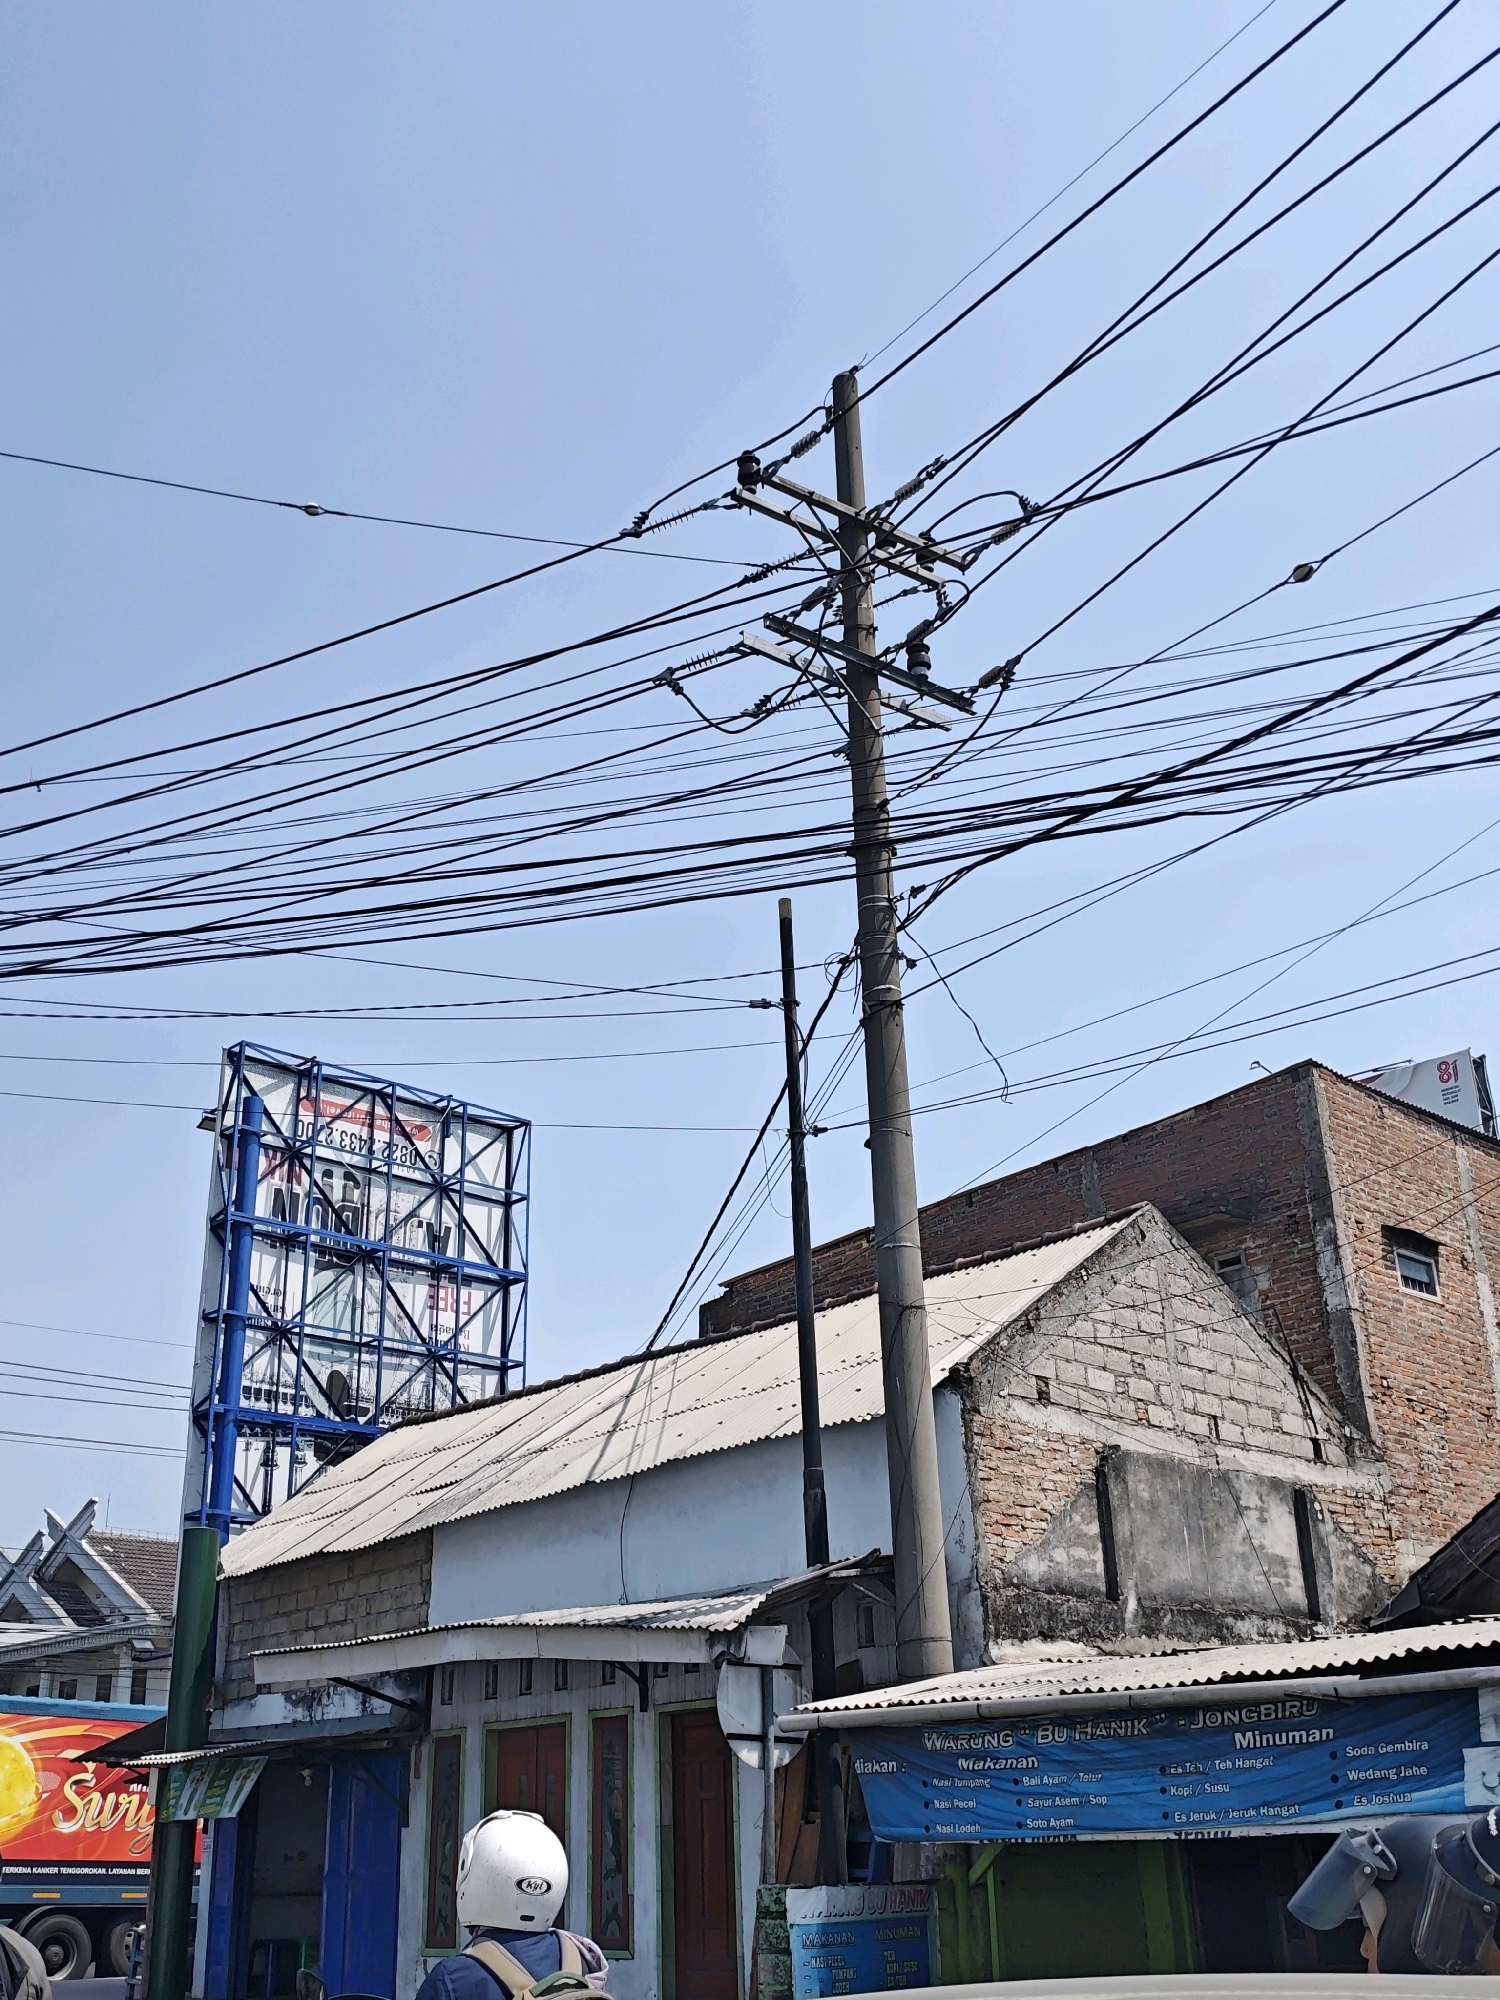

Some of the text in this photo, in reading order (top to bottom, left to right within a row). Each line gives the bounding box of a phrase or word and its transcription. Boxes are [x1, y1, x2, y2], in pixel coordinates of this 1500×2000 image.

[1437, 1058, 1459, 1084] 81
[922, 1730, 1015, 1752] WARUNG
[1189, 1700, 1319, 1731] JONGBIRU
[1233, 1728, 1334, 1750] Minuman
[1345, 1739, 1429, 1757] Soda Gembira
[957, 1755, 1039, 1771] Makanan
[1169, 1763, 1183, 1775] Es
[1184, 1762, 1203, 1774] Teh
[1213, 1759, 1232, 1770] Teh
[1234, 1756, 1274, 1771] Hangat
[1022, 1775, 1041, 1787] Bali
[1042, 1774, 1068, 1788] Ayam
[1078, 1772, 1102, 1783] Telur
[1346, 1764, 1428, 1782] Wedang Jahe
[932, 1777, 991, 1789] Nasi Tumpang
[1169, 1785, 1193, 1797] Kopi
[1204, 1782, 1230, 1794] Susu
[934, 1798, 977, 1809] Nasi Pecel
[1027, 1797, 1053, 1809] Sayur
[1053, 1796, 1079, 1807] Asem
[1088, 1793, 1107, 1805] Sop
[1353, 1791, 1412, 1806] Es Joshua
[1174, 1811, 1187, 1822] Es
[1188, 1810, 1217, 1822] Jeruk
[1226, 1806, 1257, 1819] Jeruk
[1259, 1803, 1300, 1818] Hangat
[936, 1823, 981, 1834] Nasi Lodeh
[1026, 1817, 1074, 1829] Soto Ayam
[2, 1866, 32, 1876] TERKENA
[32, 1866, 59, 1876] KANKER
[108, 1867, 136, 1877] LAYANAN
[889, 1887, 931, 1915] HANIK
[802, 1931, 855, 1946] MAKANAN
[875, 1926, 921, 1940] MINUMAN
[811, 1956, 827, 1968] NASI
[887, 1962, 899, 1974] KOPI
[832, 1981, 850, 1994] LODEH
